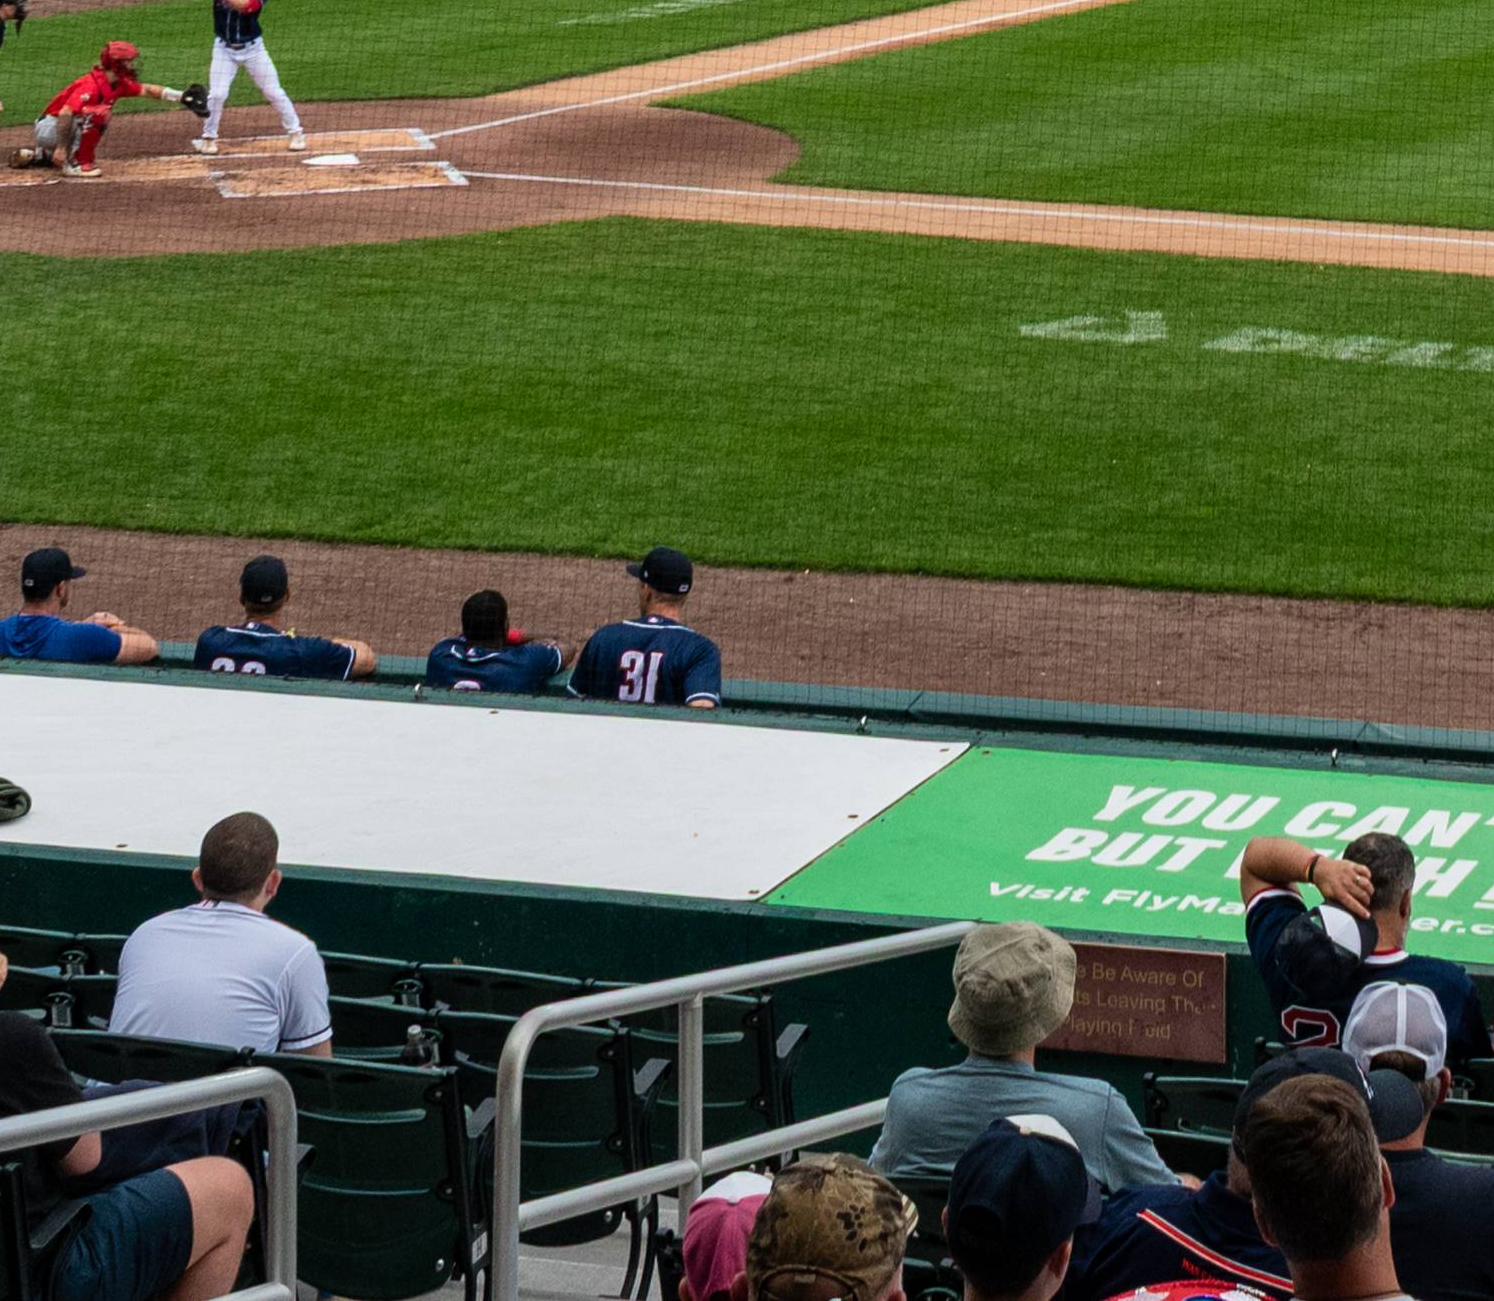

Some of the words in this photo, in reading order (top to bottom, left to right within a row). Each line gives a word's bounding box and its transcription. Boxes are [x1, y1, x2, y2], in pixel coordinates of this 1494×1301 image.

[618, 649, 664, 704] 31
[1092, 784, 1281, 832] YOU
[1025, 827, 1228, 873] BUT
[990, 881, 1091, 903] Visit
[1092, 961, 1115, 981] Be
[1121, 965, 1177, 987] Aware
[1182, 969, 1205, 989] Of
[1097, 989, 1167, 1013] Leaving
